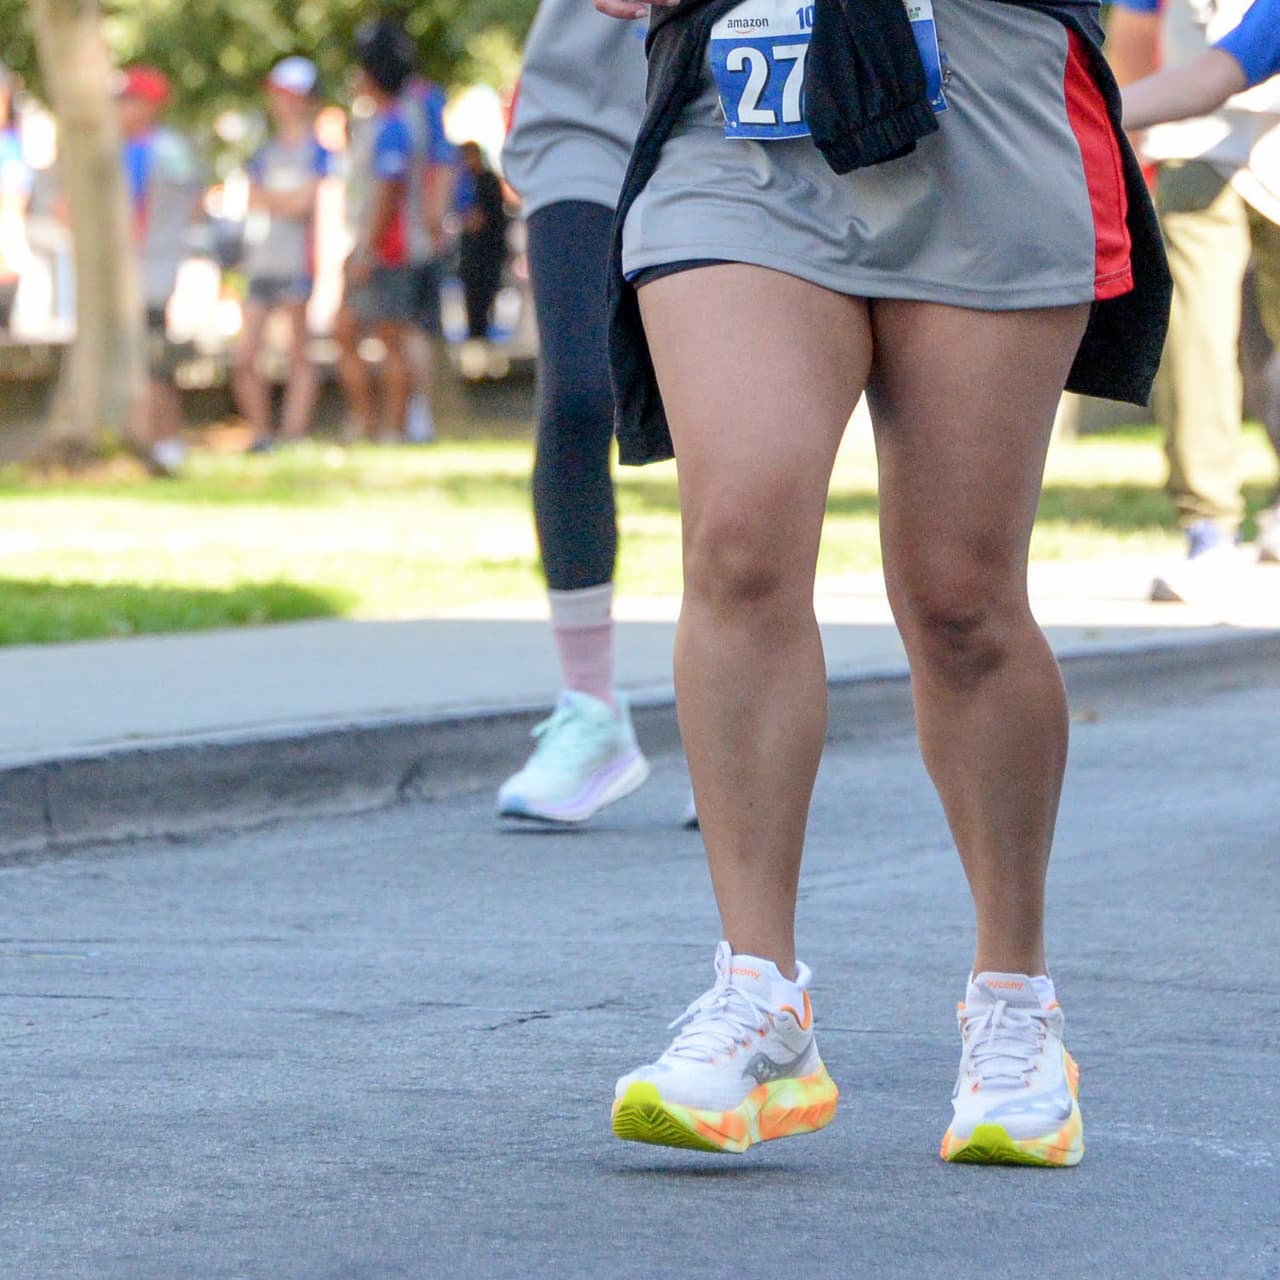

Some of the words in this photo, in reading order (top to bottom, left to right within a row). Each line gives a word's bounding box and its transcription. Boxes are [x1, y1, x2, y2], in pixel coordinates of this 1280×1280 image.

[727, 17, 770, 29] amazon
[796, 5, 815, 31] 10
[726, 43, 810, 125] 27
